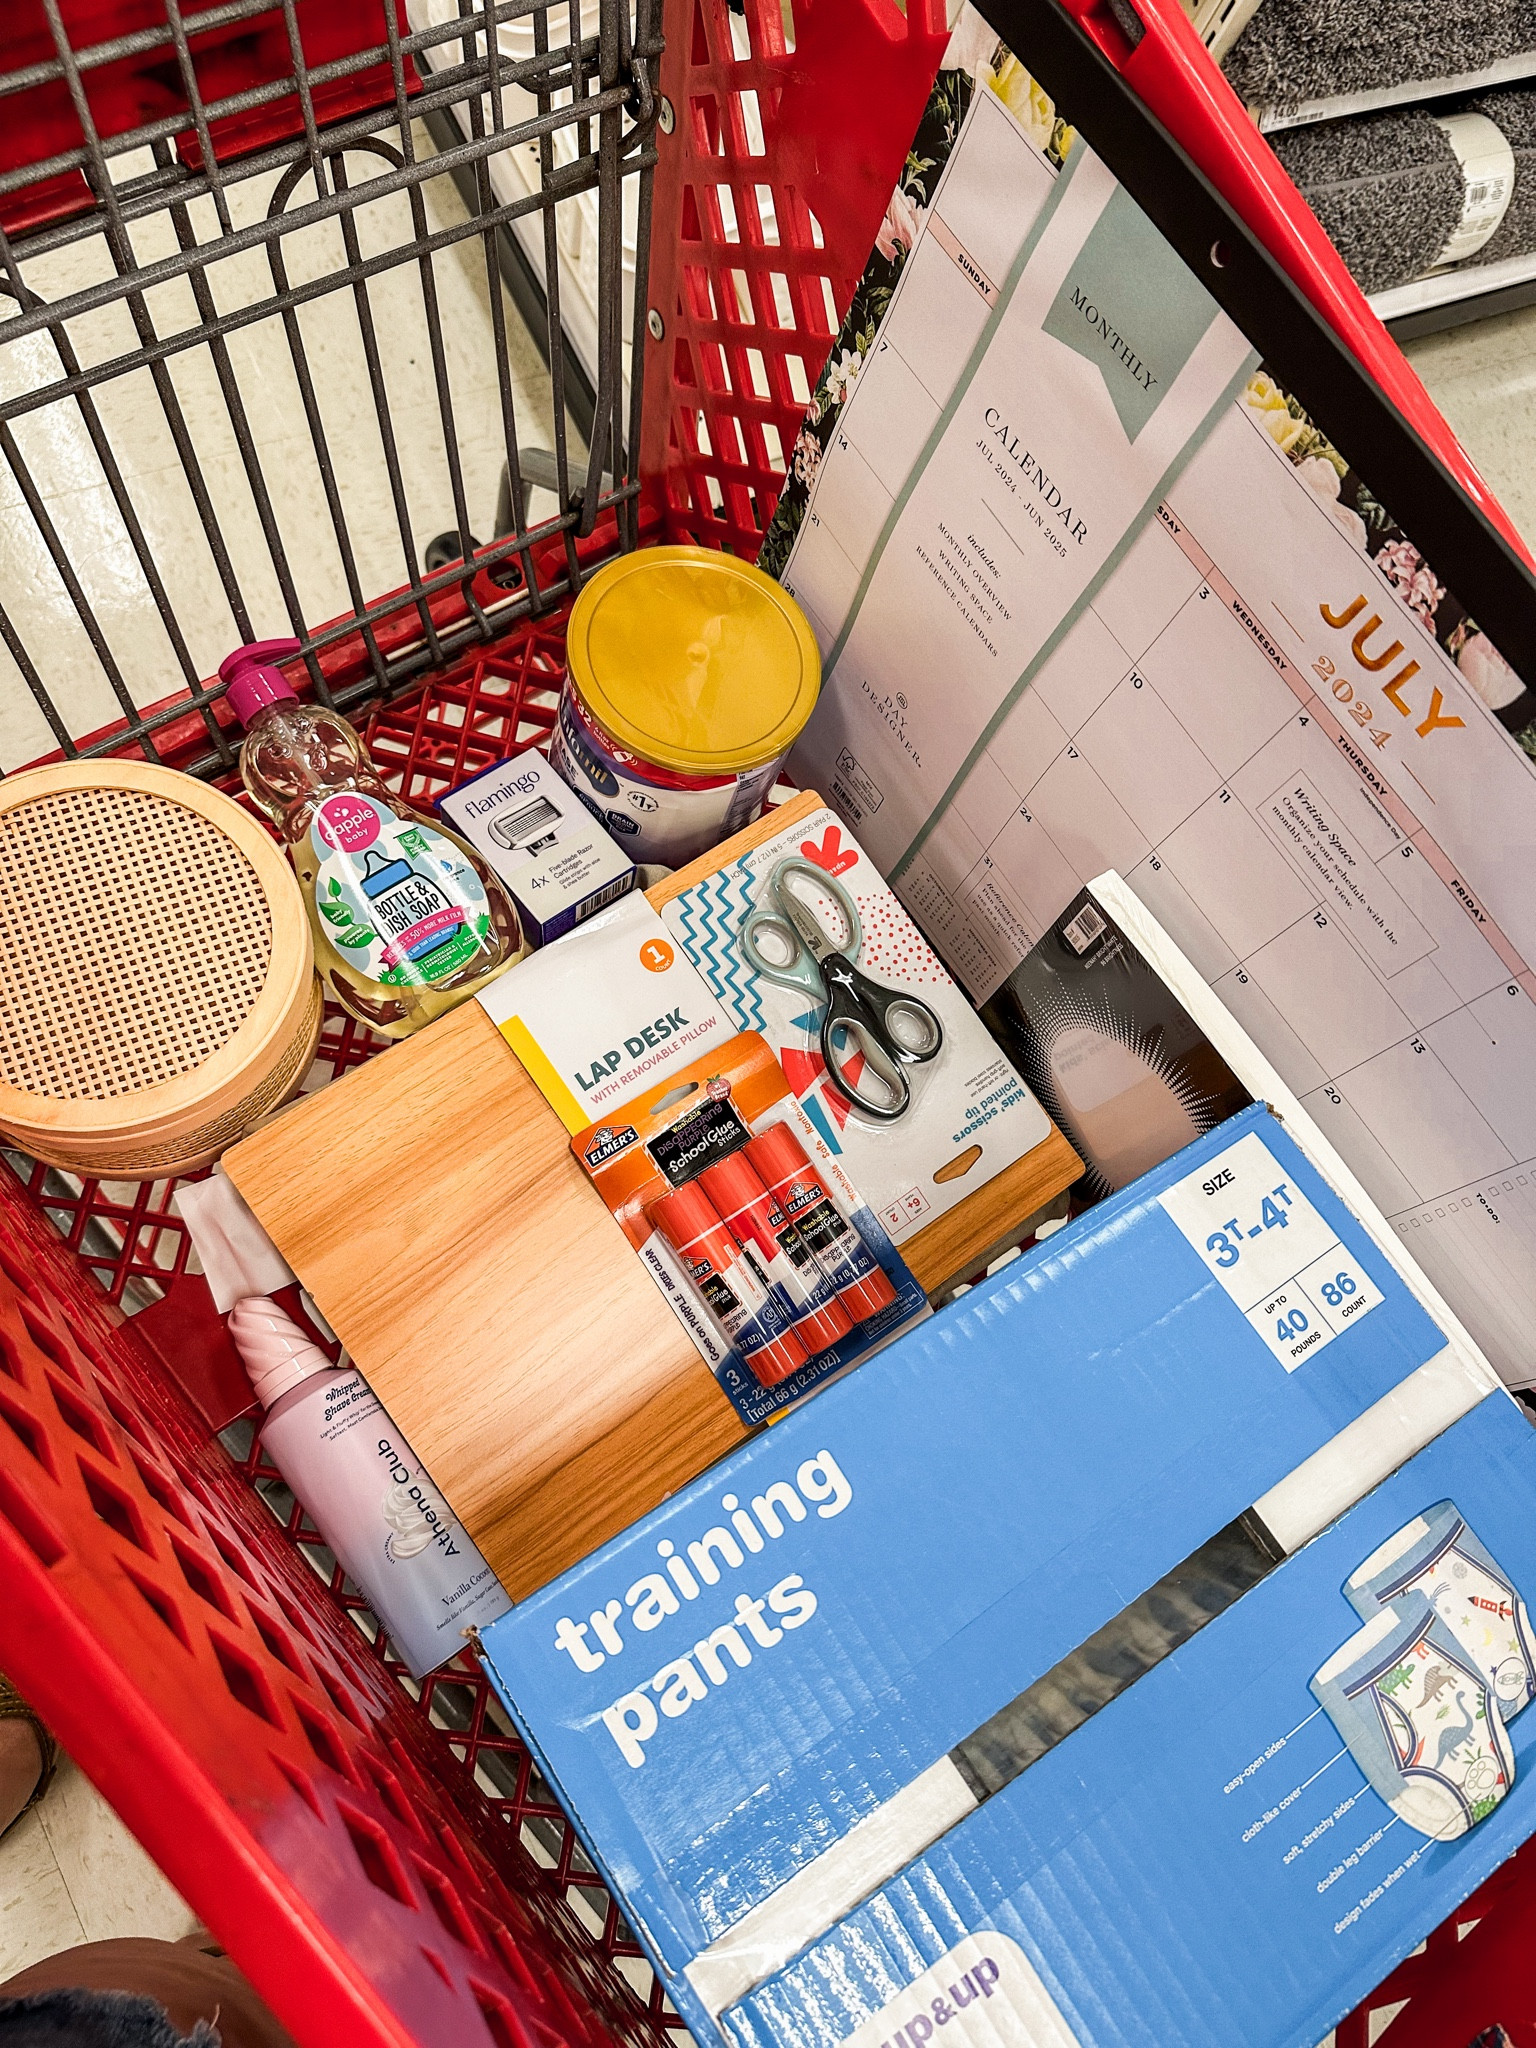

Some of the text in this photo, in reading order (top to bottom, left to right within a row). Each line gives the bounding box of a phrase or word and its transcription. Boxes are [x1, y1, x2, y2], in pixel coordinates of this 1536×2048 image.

[1272, 104, 1299, 118] 14.00
[957, 253, 991, 295] SUNDAY
[880, 341, 889, 352] 7
[1069, 286, 1159, 392] MONTHLY
[838, 435, 848, 450] 14
[985, 408, 1088, 545] CALENDAR
[976, 440, 1068, 558] JUL 2024 JUN 2025
[1156, 505, 1181, 534] SDAY
[967, 534, 1001, 579] includes:
[938, 522, 1012, 621] MONTHLY OVERVIEW
[785, 583, 796, 598] 28
[916, 545, 998, 657] REFERENCE CALENDARS
[939, 549, 993, 624] WRITING SPACE
[1199, 587, 1210, 600] 3
[1232, 600, 1288, 670] WEDNESDAY
[1129, 671, 1143, 689] 10
[1319, 593, 1467, 739] JULY
[577, 700, 592, 728] 32
[884, 696, 909, 728] DAY
[1311, 655, 1392, 751] 2024
[1299, 716, 1310, 727] 4
[1066, 745, 1079, 760] 17
[1337, 735, 1389, 796] THURSDAY
[464, 770, 540, 819] flamingo
[1219, 789, 1232, 804] 11
[1019, 807, 1033, 823] 24
[1294, 788, 1357, 867] Writing Space
[1359, 787, 1402, 840] Independence Day
[345, 829, 369, 844] baby
[786, 817, 826, 843] PAIR SCISSORS
[548, 843, 594, 874] Five-blade Razor
[1272, 806, 1303, 845] monthly
[1302, 844, 1335, 884] calendar
[1401, 846, 1414, 858] 5
[553, 859, 583, 879] Cartridges
[575, 870, 591, 883] butter
[984, 855, 994, 869] 31
[1148, 855, 1162, 871] 18
[1282, 796, 1398, 946] Organize your schedule with the
[530, 875, 550, 890] 4x
[558, 868, 584, 886] Glide strips
[374, 881, 431, 920] BOTTLE &
[986, 883, 1017, 923] Reference
[1451, 879, 1487, 923] FRIDAY
[381, 893, 441, 938] DISH SOAP
[409, 926, 425, 940] 50%
[423, 921, 438, 931] MORE
[437, 914, 451, 924] MILK
[449, 911, 462, 920] FILM
[1312, 911, 1328, 929] 12
[646, 945, 665, 964] 1
[655, 959, 672, 972] COUNT
[1234, 968, 1249, 985] 19
[1506, 985, 1519, 996] 6
[574, 1007, 690, 1092] LAP DESK
[590, 1016, 718, 1104] WITH REMOVABLE PILLOW
[1410, 1037, 1426, 1055] 13
[965, 1076, 1018, 1119] pointed tip
[1324, 1086, 1342, 1106] 20
[671, 1110, 702, 1134] Washable
[790, 1100, 815, 1135] Nontoxic
[952, 1107, 998, 1143] scissors
[590, 1130, 637, 1165] ELMER'S
[717, 1127, 741, 1147] Sticks
[816, 1139, 830, 1159] Safe
[831, 1163, 857, 1202] Washable
[1201, 1168, 1236, 1197] SIZE
[788, 1187, 822, 1213] ELMER'S
[889, 1197, 921, 1223] 6+ 2
[801, 1209, 830, 1231] Washable
[645, 1248, 720, 1361] Goes on PURPLE DRIES CLEAR
[812, 1290, 821, 1300] 22
[1264, 1295, 1288, 1315] UP TO
[1276, 1272, 1357, 1342] 40 86
[1290, 1295, 1367, 1358] POUNDS COUNT
[325, 1377, 360, 1402] Whipped
[726, 1369, 740, 1386] 3
[732, 1382, 749, 1396] sticks
[746, 1397, 777, 1422] [Total
[775, 1388, 790, 1403] 66
[789, 1384, 799, 1395] g
[795, 1365, 821, 1388] (2.31
[818, 1350, 841, 1371] OZ)]
[324, 1398, 351, 1422] Shave
[740, 1385, 767, 1409] 3 22
[377, 1439, 461, 1558] Athena Club
[554, 1449, 853, 1673] training
[441, 1583, 472, 1606] Vanilla
[601, 1574, 818, 1769] pants
[1223, 1737, 1288, 1795] easy-open sides
[1241, 1787, 1302, 1843] cloth-like cover
[1282, 1796, 1357, 1865] soft, stretchy sides
[1316, 1828, 1384, 1894] double leg barrier
[1334, 1849, 1421, 1935] design fades when wet
